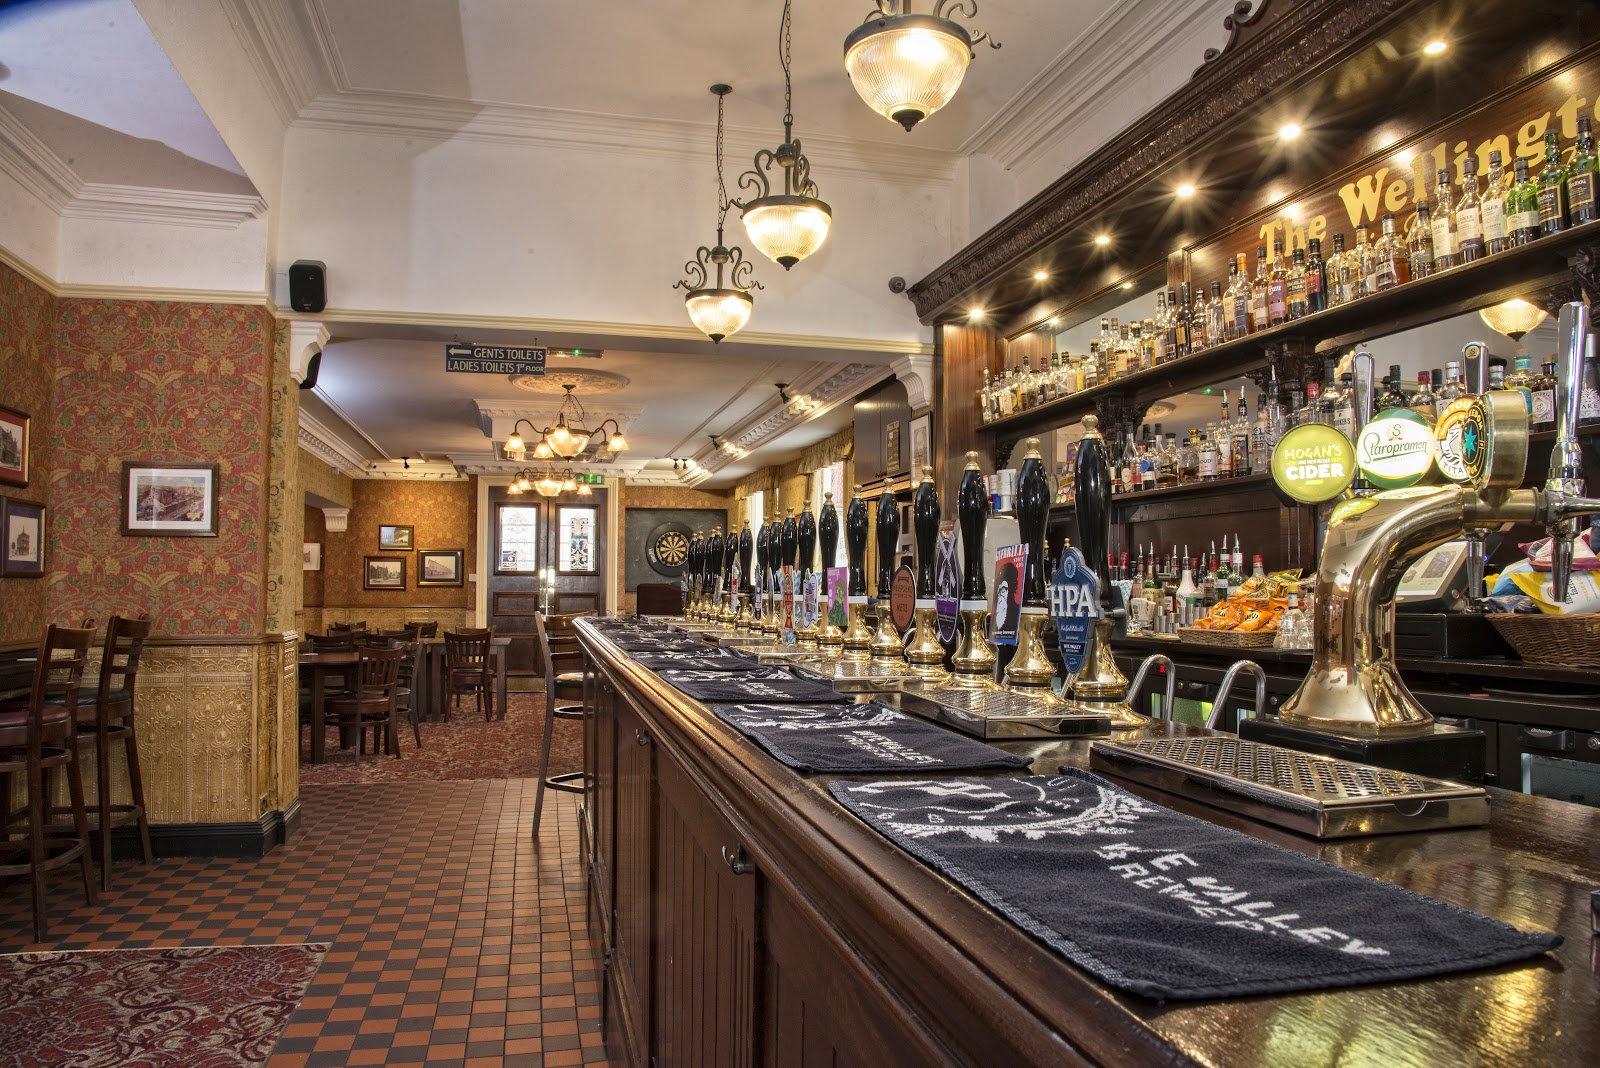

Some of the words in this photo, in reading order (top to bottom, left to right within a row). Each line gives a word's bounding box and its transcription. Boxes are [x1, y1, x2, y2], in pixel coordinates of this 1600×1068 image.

[1259, 214, 1327, 265] The
[474, 348, 504, 359] GENTS
[506, 349, 543, 360] TOILETS
[448, 361, 479, 371] LADIES
[481, 361, 514, 373] TOILETS
[1443, 400, 1471, 417] STOU
[1284, 444, 1343, 460] HOGAN'S
[1363, 432, 1428, 464] Staropramen
[1285, 463, 1345, 480] CIDER
[1443, 461, 1464, 474] TITA
[1050, 584, 1098, 617] HPA
